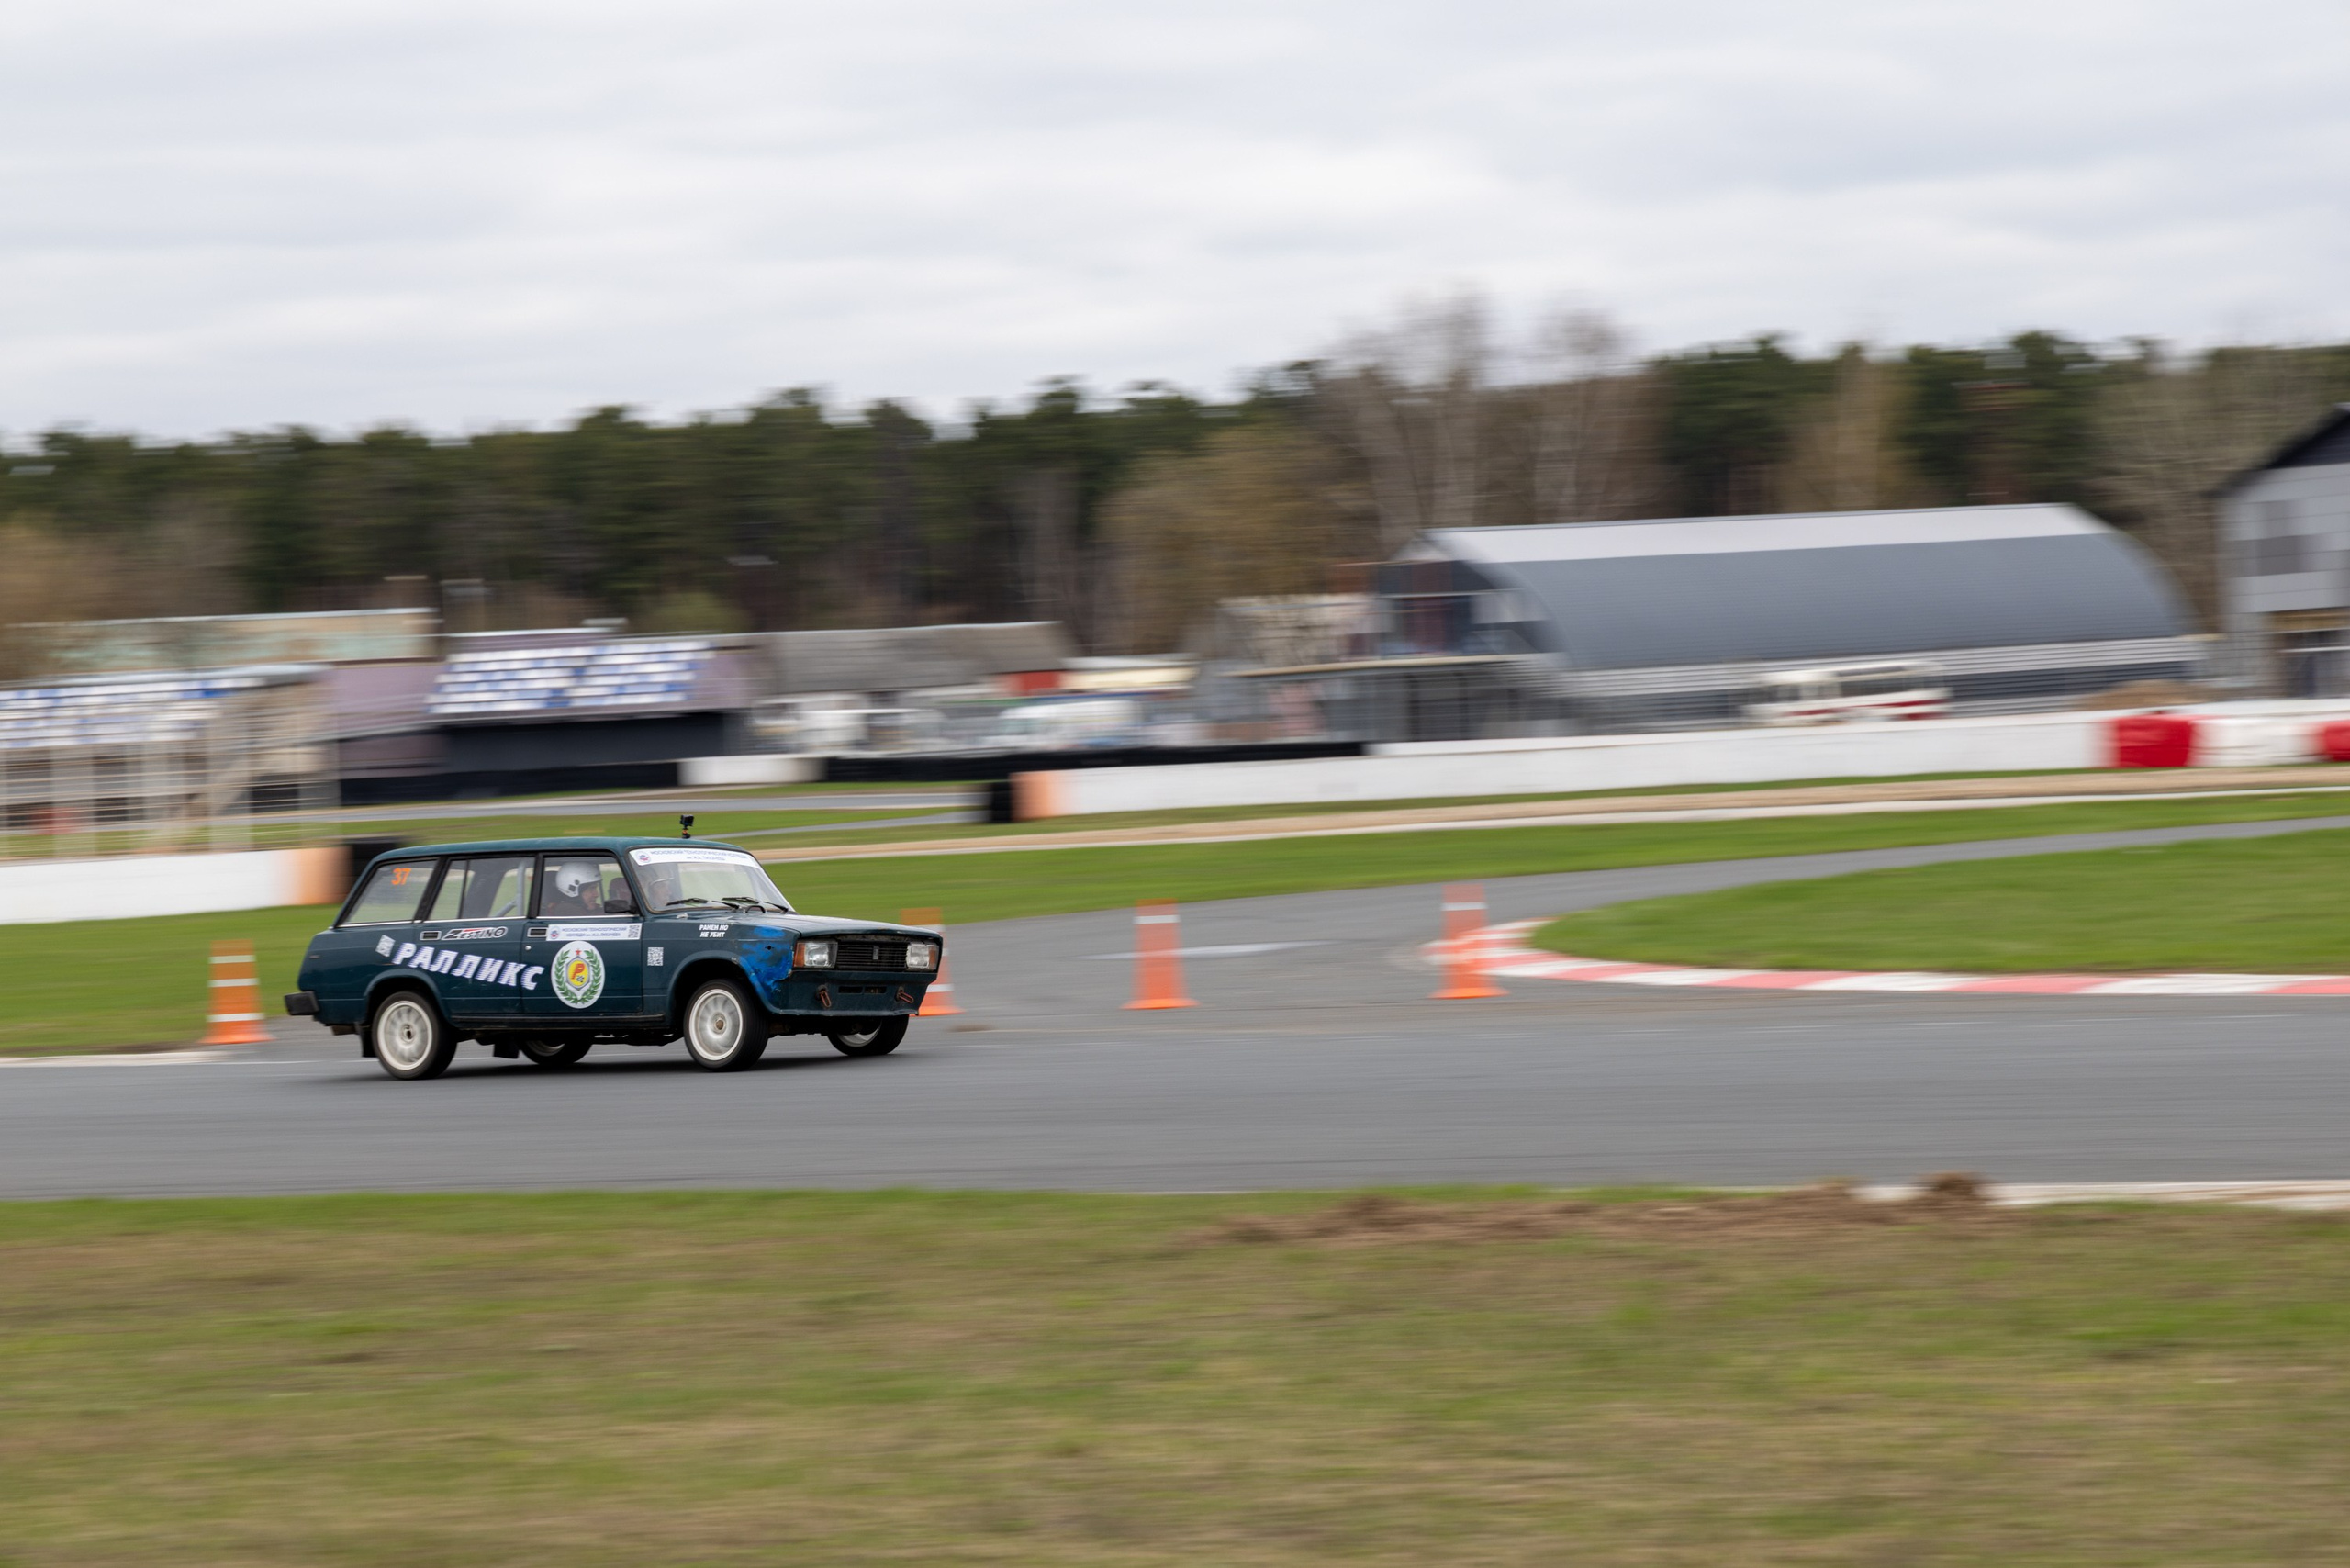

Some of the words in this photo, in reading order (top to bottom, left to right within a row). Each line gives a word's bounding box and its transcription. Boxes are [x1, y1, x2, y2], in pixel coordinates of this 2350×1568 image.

[391, 868, 411, 885] 37
[442, 926, 508, 940] ZESTINO
[391, 942, 544, 991] РАЛЛИКС
